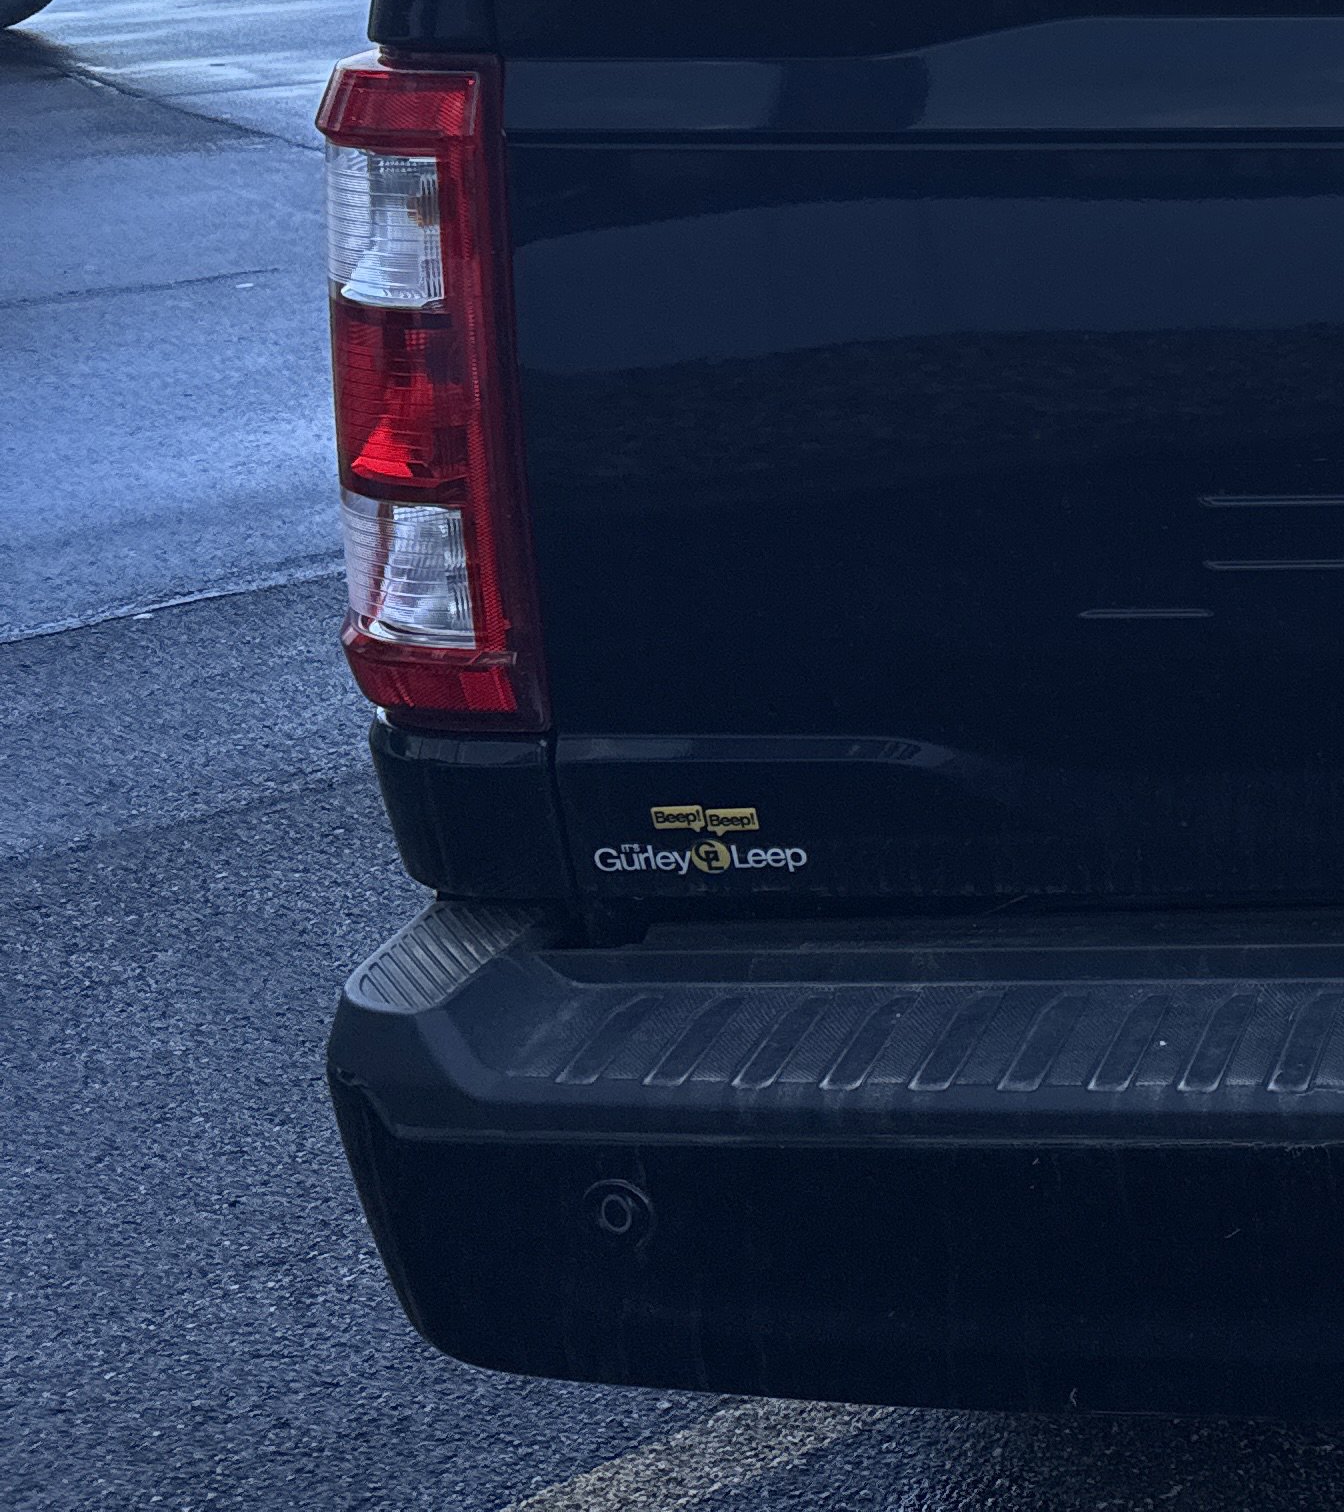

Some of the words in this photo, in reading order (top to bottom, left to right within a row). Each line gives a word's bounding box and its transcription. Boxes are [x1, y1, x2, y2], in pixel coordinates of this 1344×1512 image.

[654, 809, 702, 825] Beep!
[708, 812, 756, 829] Beep!
[594, 844, 692, 875] Gurley
[730, 844, 808, 873] Leep
